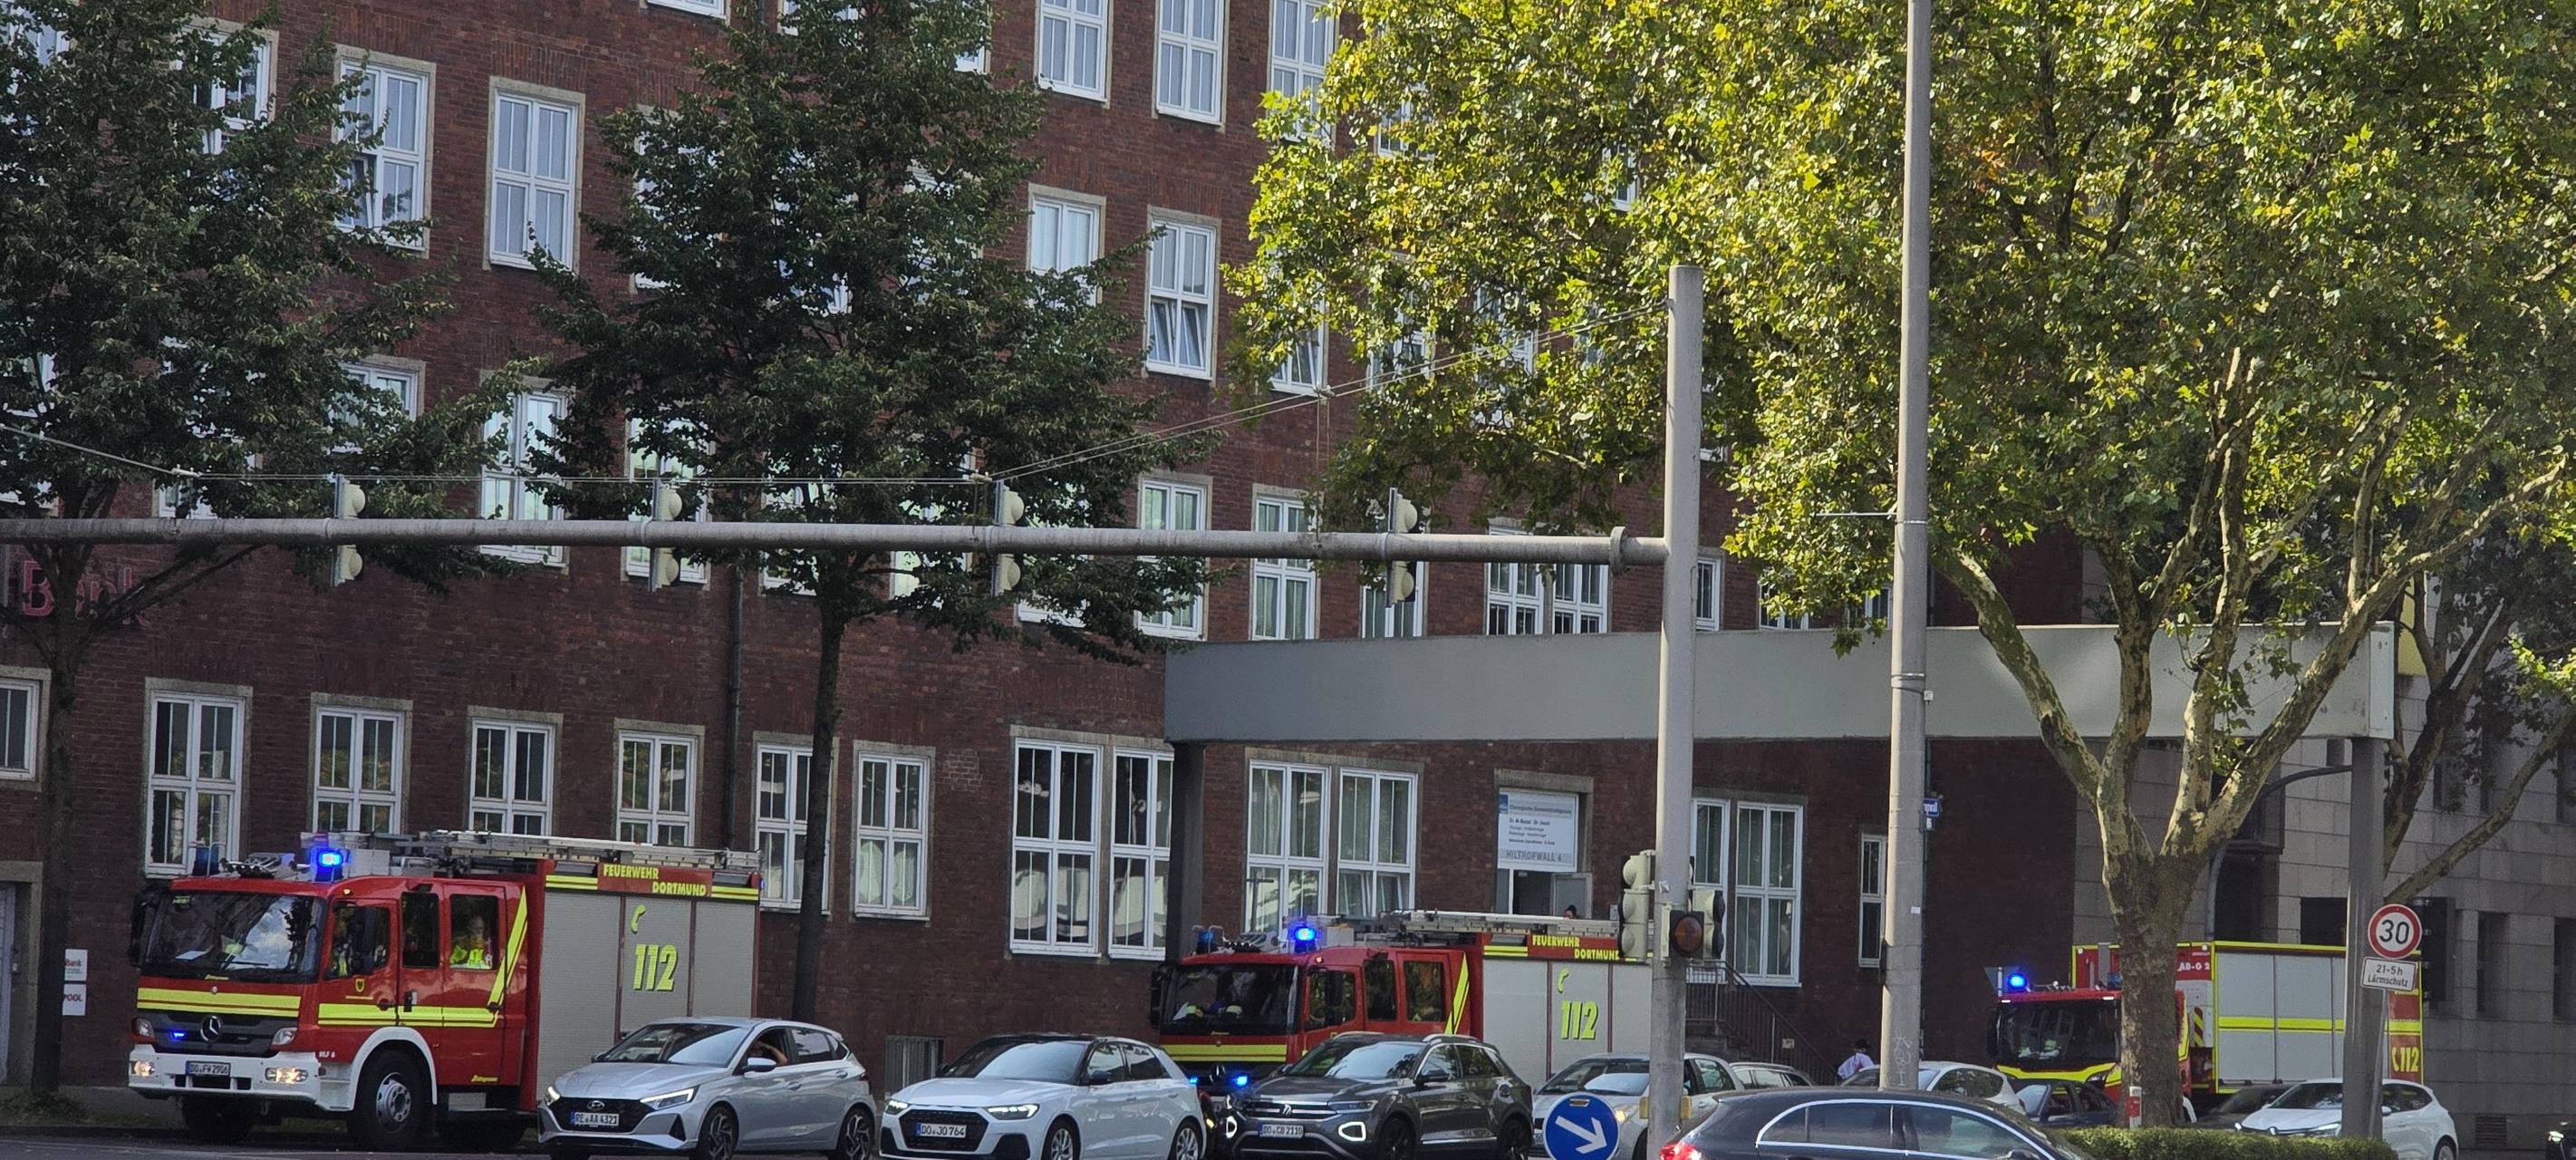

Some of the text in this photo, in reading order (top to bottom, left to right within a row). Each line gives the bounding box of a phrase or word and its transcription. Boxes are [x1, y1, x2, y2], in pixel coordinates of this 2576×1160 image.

[603, 864, 659, 879] FEUERWEHR
[652, 882, 706, 896] DORTMUND
[1532, 935, 1580, 947] FEUERWEHR
[2379, 919, 2410, 945] 30
[633, 944, 678, 991] 112
[2368, 974, 2408, 987] Lärmschutz
[1560, 1000, 1598, 1039] 112
[2400, 1047, 2419, 1072] 112
